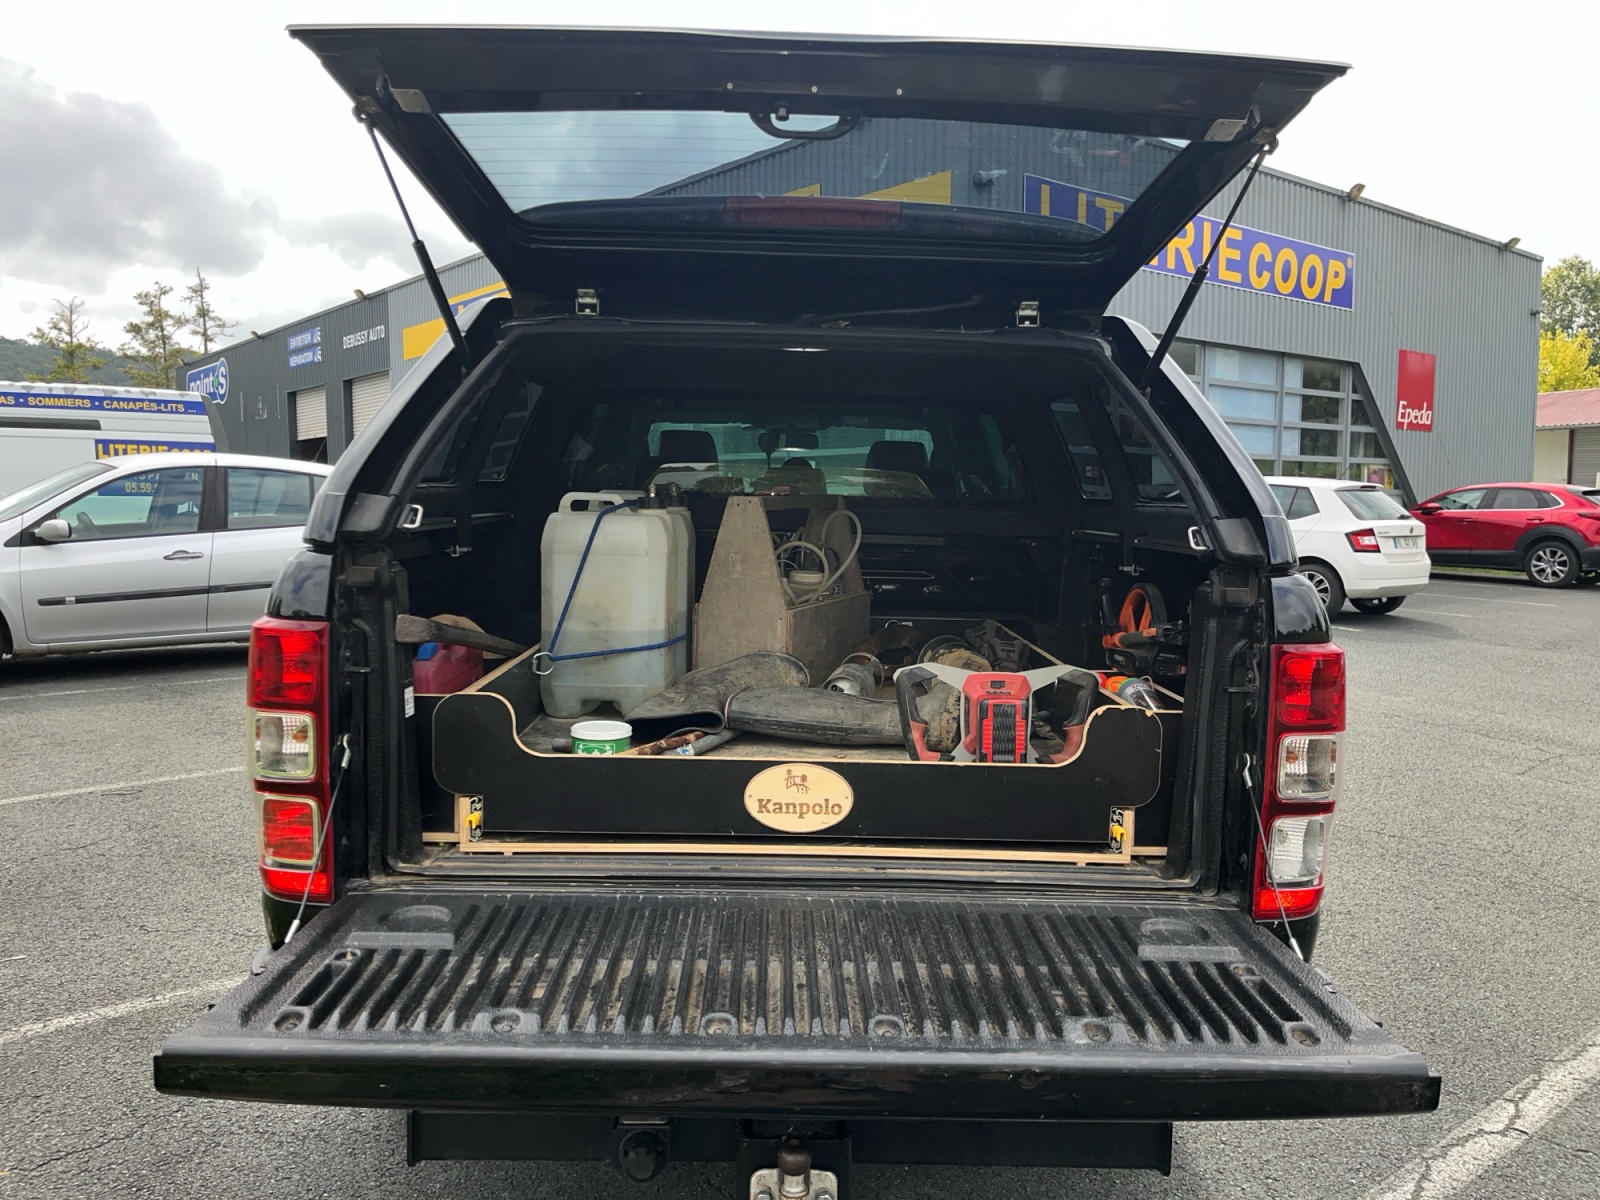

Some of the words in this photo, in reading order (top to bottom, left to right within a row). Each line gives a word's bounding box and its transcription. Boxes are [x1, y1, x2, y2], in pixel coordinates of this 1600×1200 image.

[1041, 183, 1243, 284] ITRIE
[1248, 242, 1346, 303] COOP
[290, 333, 312, 349] ENTRETIEN
[343, 330, 369, 349] DEBUSSY
[369, 325, 385, 342] AUTO
[28, 396, 91, 408] SOMMIERS
[103, 400, 185, 412] CANAPÉS-LITS
[1397, 400, 1432, 430] Epeda
[757, 798, 843, 819] Kanpolo
